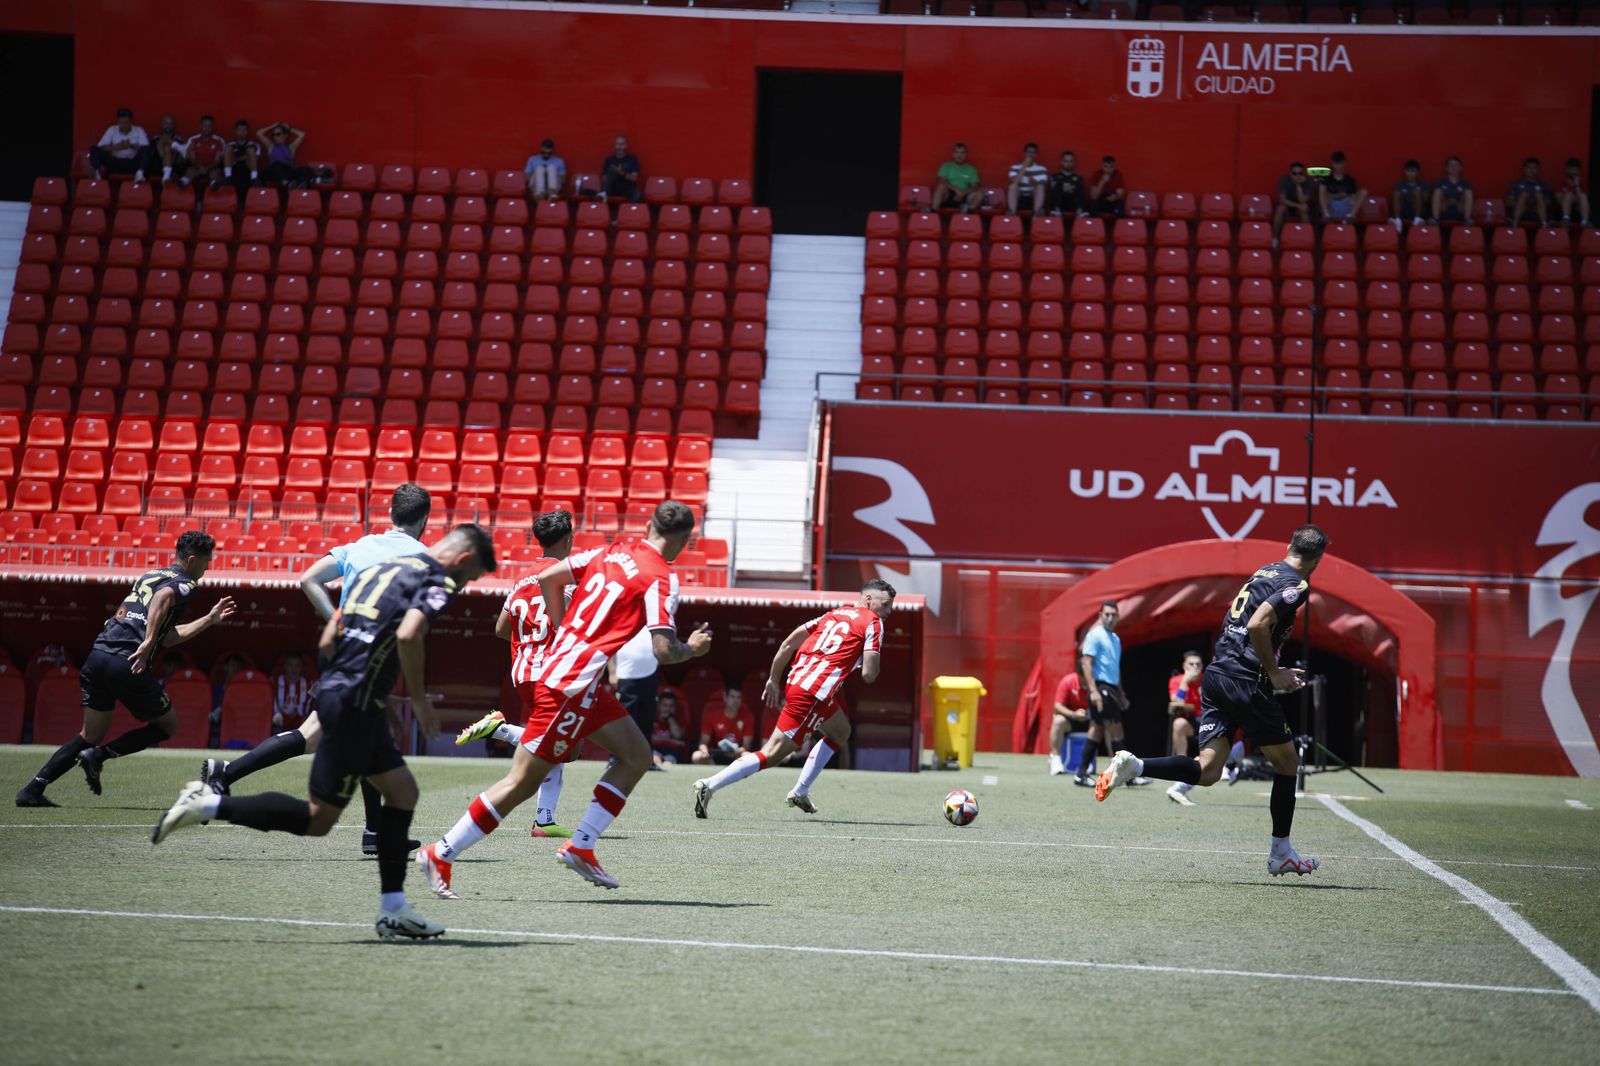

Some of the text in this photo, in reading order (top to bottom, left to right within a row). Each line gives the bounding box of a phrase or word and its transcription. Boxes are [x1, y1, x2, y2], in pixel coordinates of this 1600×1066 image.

[1196, 37, 1354, 73] ALMERÍA
[1195, 75, 1276, 95] CIUDAD
[1069, 467, 1398, 508] UD ALMERÍA
[343, 564, 402, 620] 11
[571, 573, 625, 637] 21
[1231, 577, 1258, 619] 6
[510, 596, 549, 643] 23
[812, 620, 849, 656] 16
[557, 711, 586, 739] 21
[808, 713, 825, 731] 16
